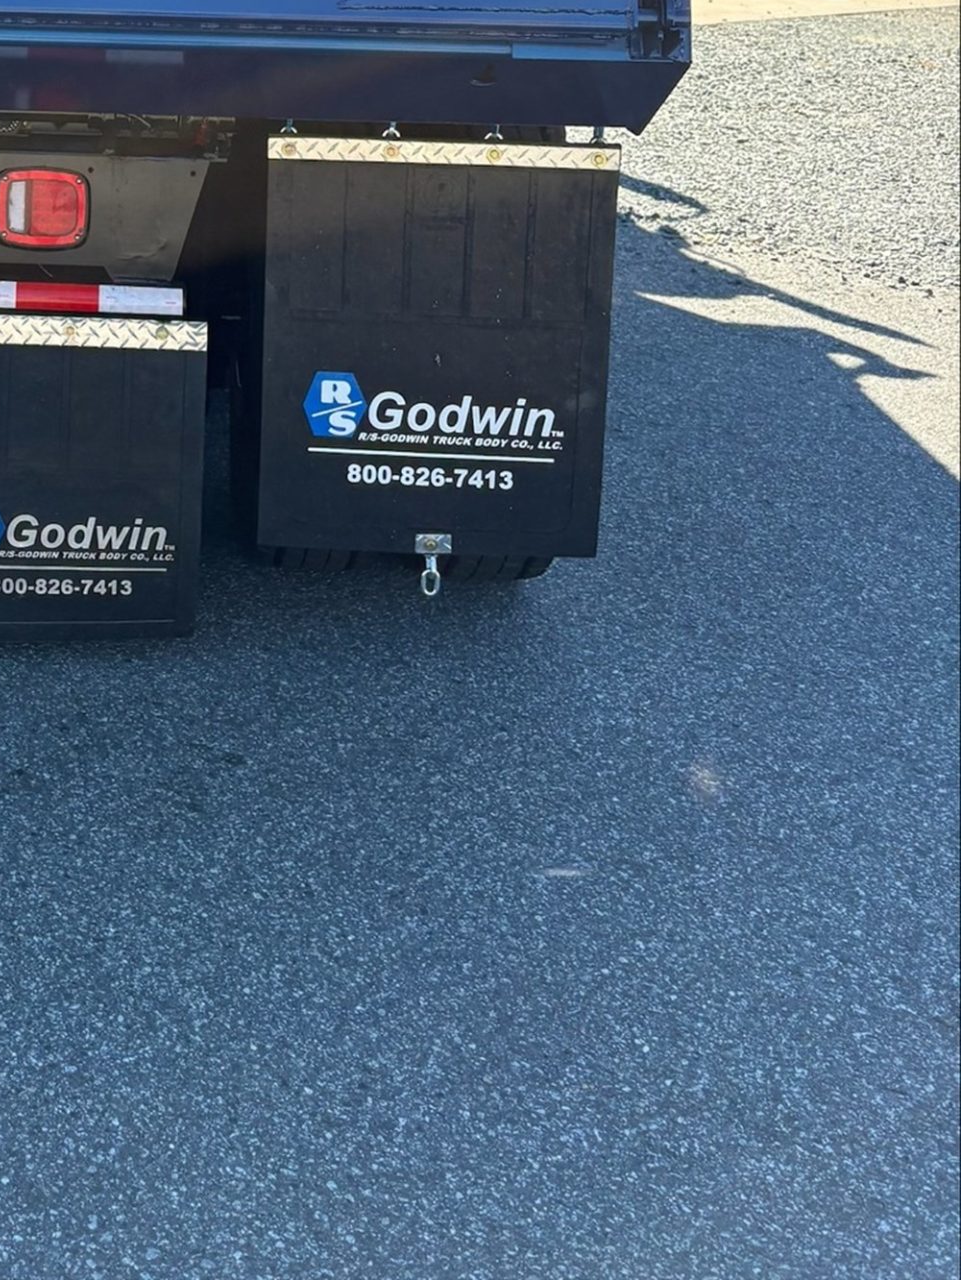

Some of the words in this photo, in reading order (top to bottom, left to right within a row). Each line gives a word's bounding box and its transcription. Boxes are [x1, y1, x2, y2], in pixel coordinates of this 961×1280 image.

[368, 391, 555, 438] Godwin
[432, 435, 472, 447] TRUCK
[475, 438, 508, 448] BODY
[347, 463, 514, 490] 800-826-7413
[6, 514, 168, 551] Godwin
[62, 551, 96, 560] TRUCK
[99, 552, 128, 561] BODY
